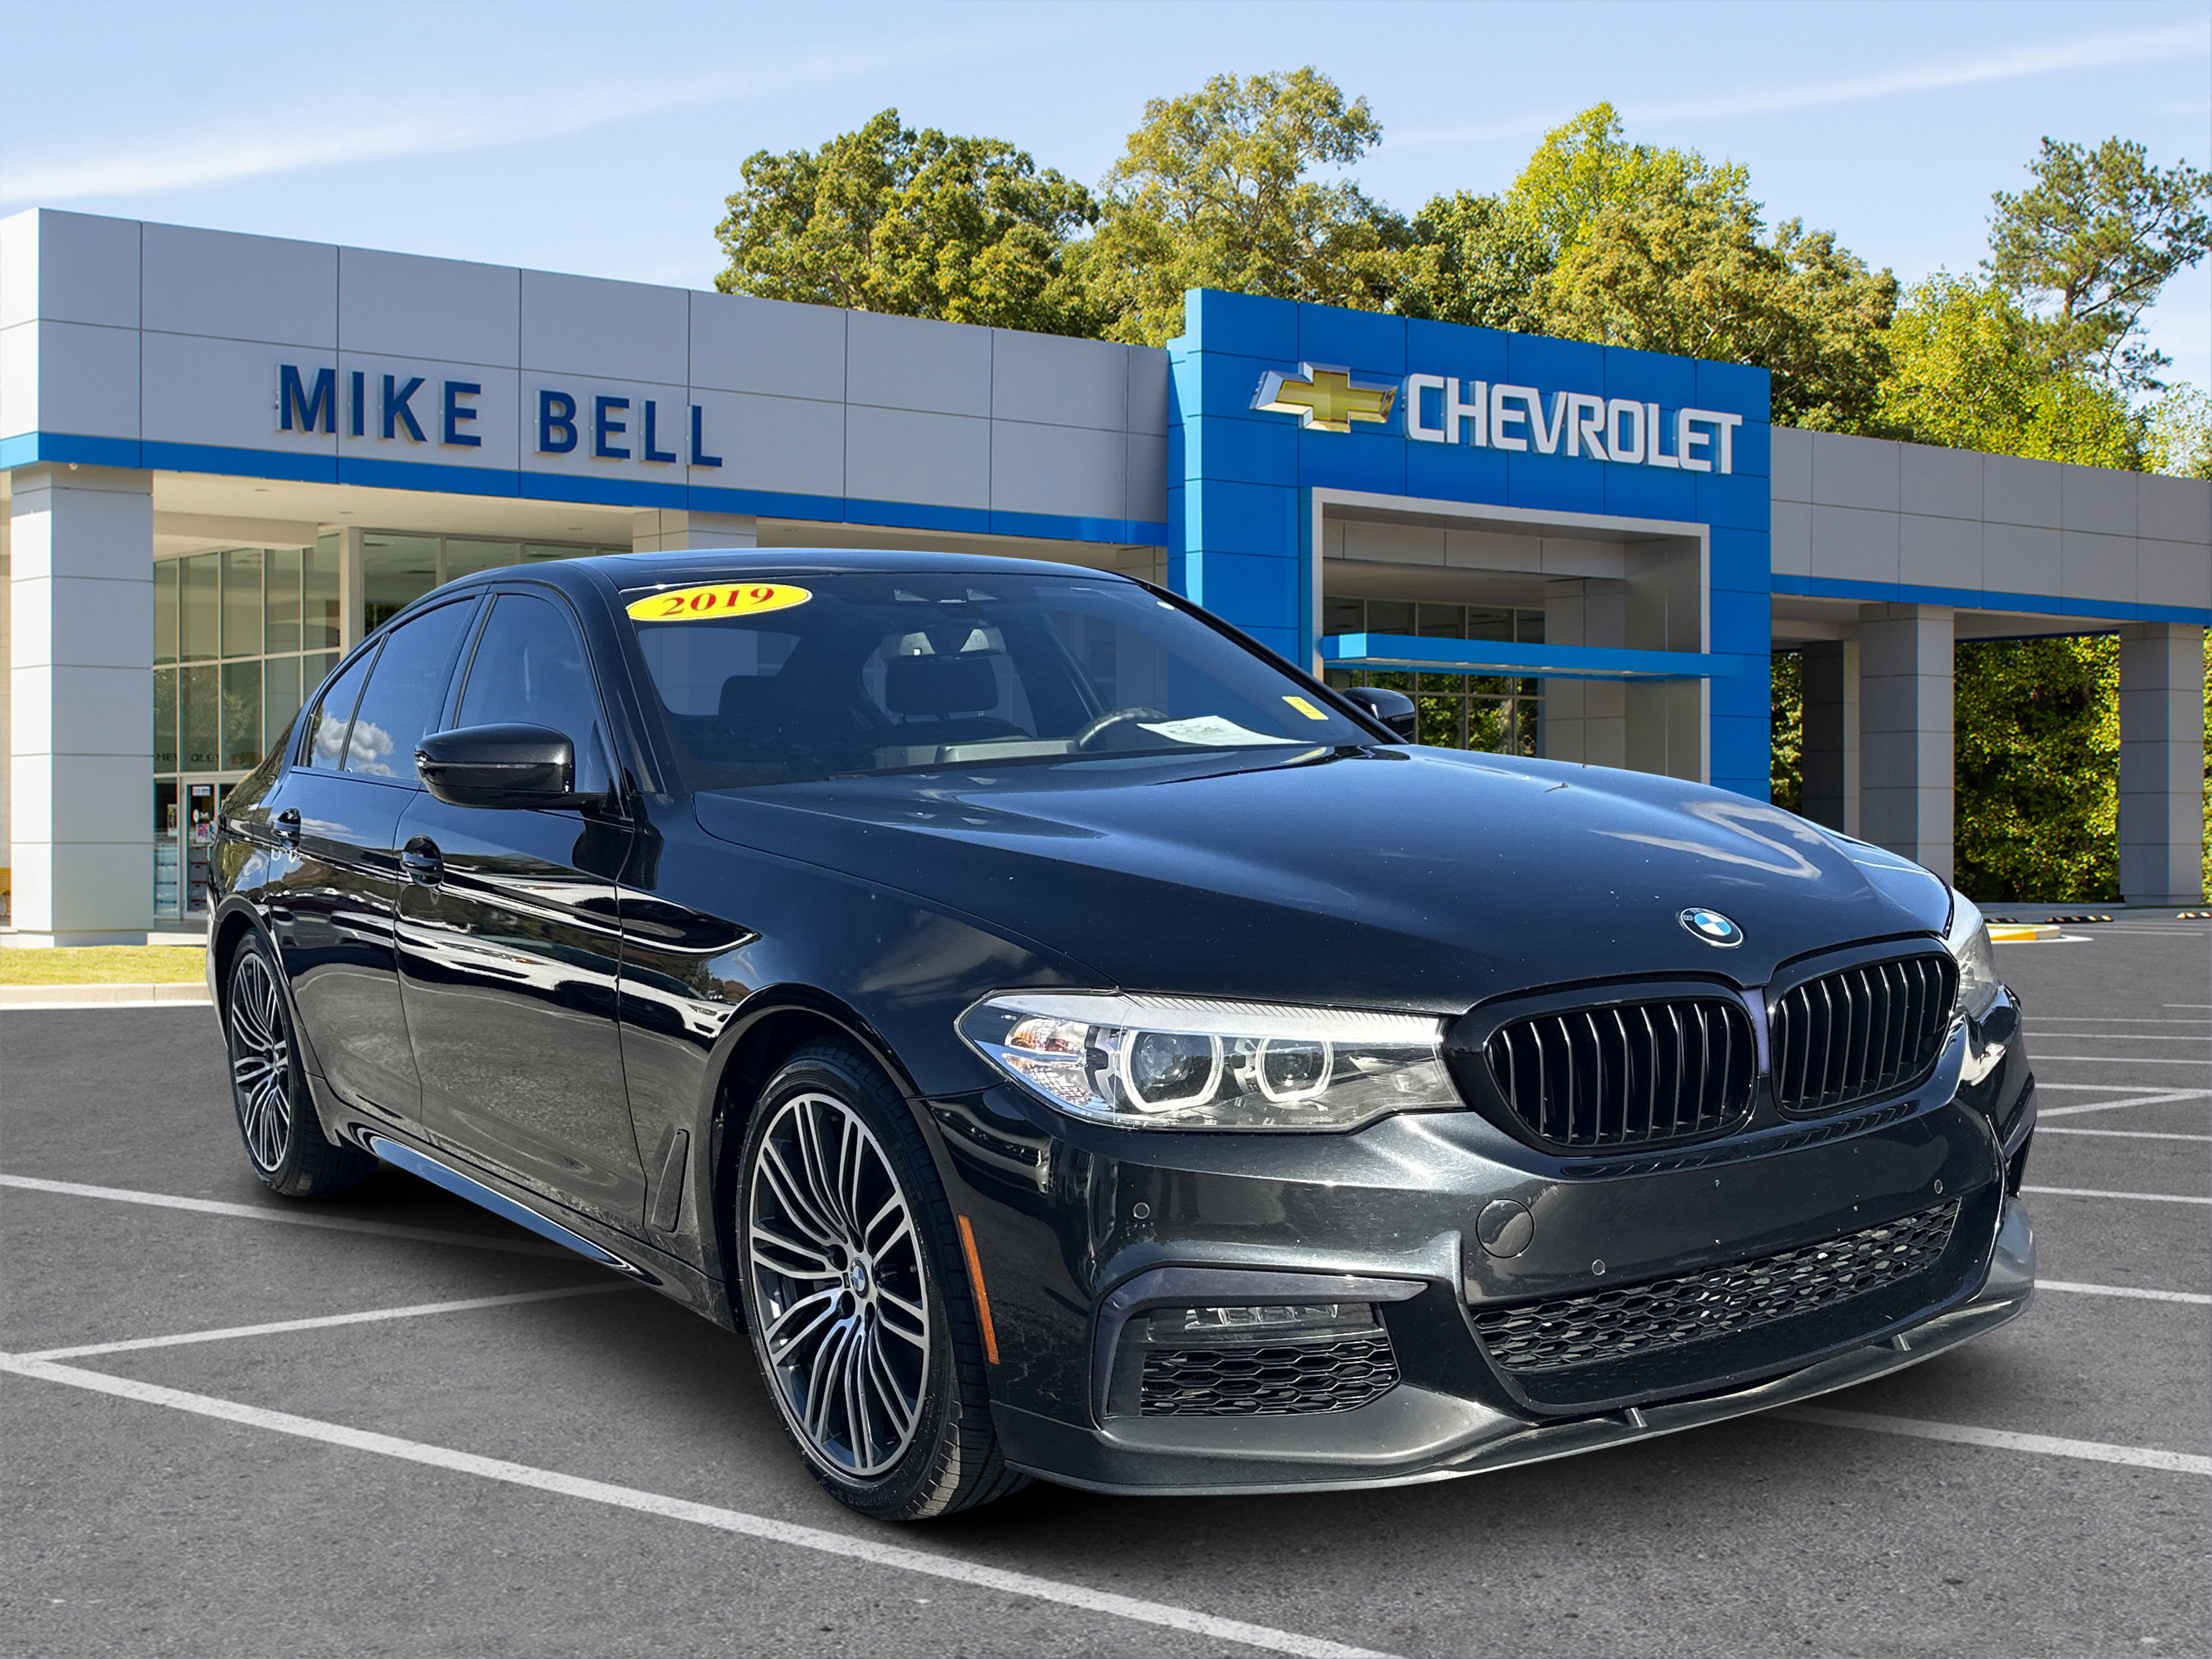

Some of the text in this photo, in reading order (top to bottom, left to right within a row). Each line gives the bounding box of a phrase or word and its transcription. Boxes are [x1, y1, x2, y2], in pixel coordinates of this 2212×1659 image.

[276, 364, 723, 467] MIKE BELL
[1402, 373, 1743, 475] CHEVROLET
[659, 587, 774, 617] 2019
